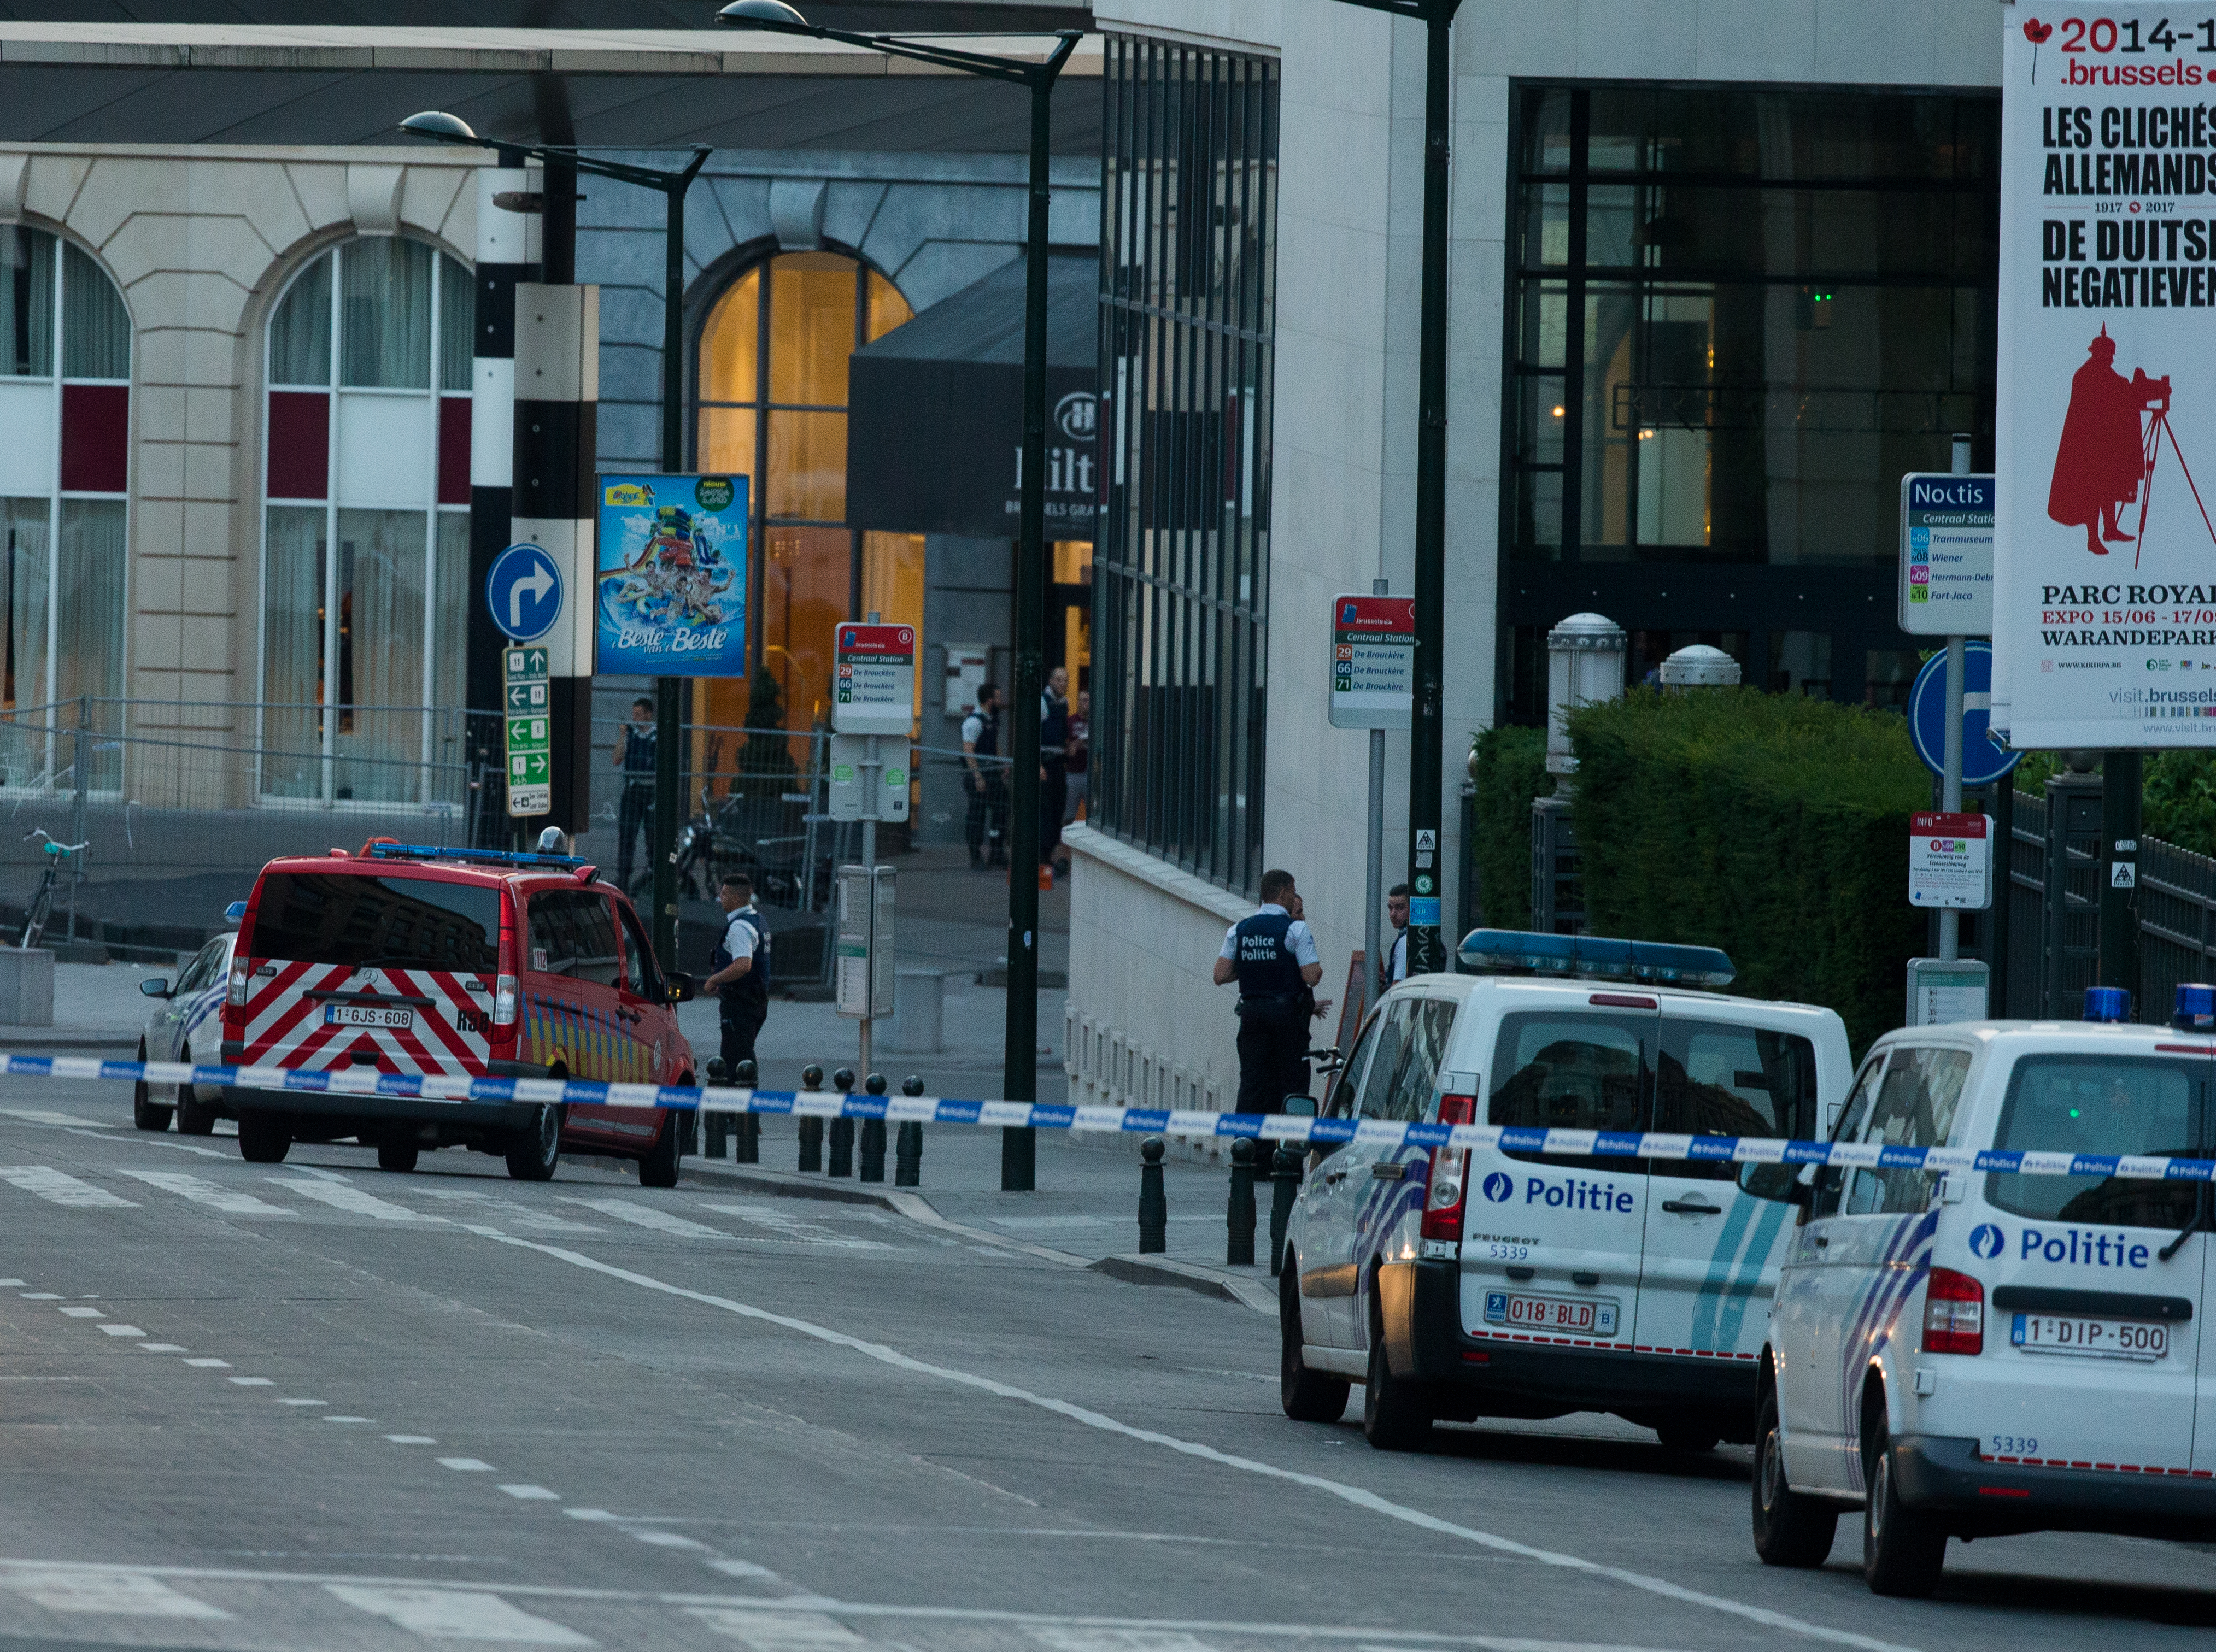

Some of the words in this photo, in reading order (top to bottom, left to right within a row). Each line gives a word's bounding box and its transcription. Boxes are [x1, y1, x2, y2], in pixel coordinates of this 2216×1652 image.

[2060, 58, 2202, 85] .brussels
[2043, 106, 2092, 148] LES
[2095, 202, 2123, 214] 1917
[2145, 202, 2175, 214] 2017
[2043, 220, 2086, 262] DE
[1915, 483, 1983, 504] Noctis
[1923, 513, 1965, 524] Centraal
[1932, 534, 1994, 544] Trammuseum
[1932, 554, 1964, 562] Wiener
[2042, 585, 2121, 605] PARC
[2042, 610, 2094, 625] EXPO
[2102, 609, 2156, 625] 15/06
[2172, 609, 2216, 625] 17/0
[618, 627, 664, 649] Beste
[671, 627, 728, 652] Beste
[1347, 633, 1383, 642] Centraal
[1385, 633, 1415, 643] Station
[848, 654, 877, 662] Centraal
[879, 655, 904, 663] Station
[1338, 648, 1351, 657] 29
[1367, 650, 1404, 659] Brouckère
[841, 667, 851, 675] 29
[1338, 663, 1351, 673] 66
[1367, 666, 1404, 675] Brouckère
[840, 680, 851, 688] 66
[1337, 679, 1350, 690] 71
[1366, 682, 1403, 690] Brouckère
[840, 692, 850, 701] 71
[1917, 817, 1932, 827] INFO
[1242, 935, 1274, 948] Police
[1241, 949, 1276, 961] Politie
[336, 1008, 409, 1026] 1-GJS-608
[457, 1009, 490, 1033] R58
[1526, 1178, 1633, 1213] Politie
[1473, 1233, 1540, 1245] PEUGEOT
[1490, 1245, 1528, 1260] 5339
[2022, 1229, 2149, 1268] Politie
[1601, 1313, 1610, 1324] B
[2031, 1320, 2164, 1350] 1-DIP-500
[1992, 1435, 2038, 1454] 5339
